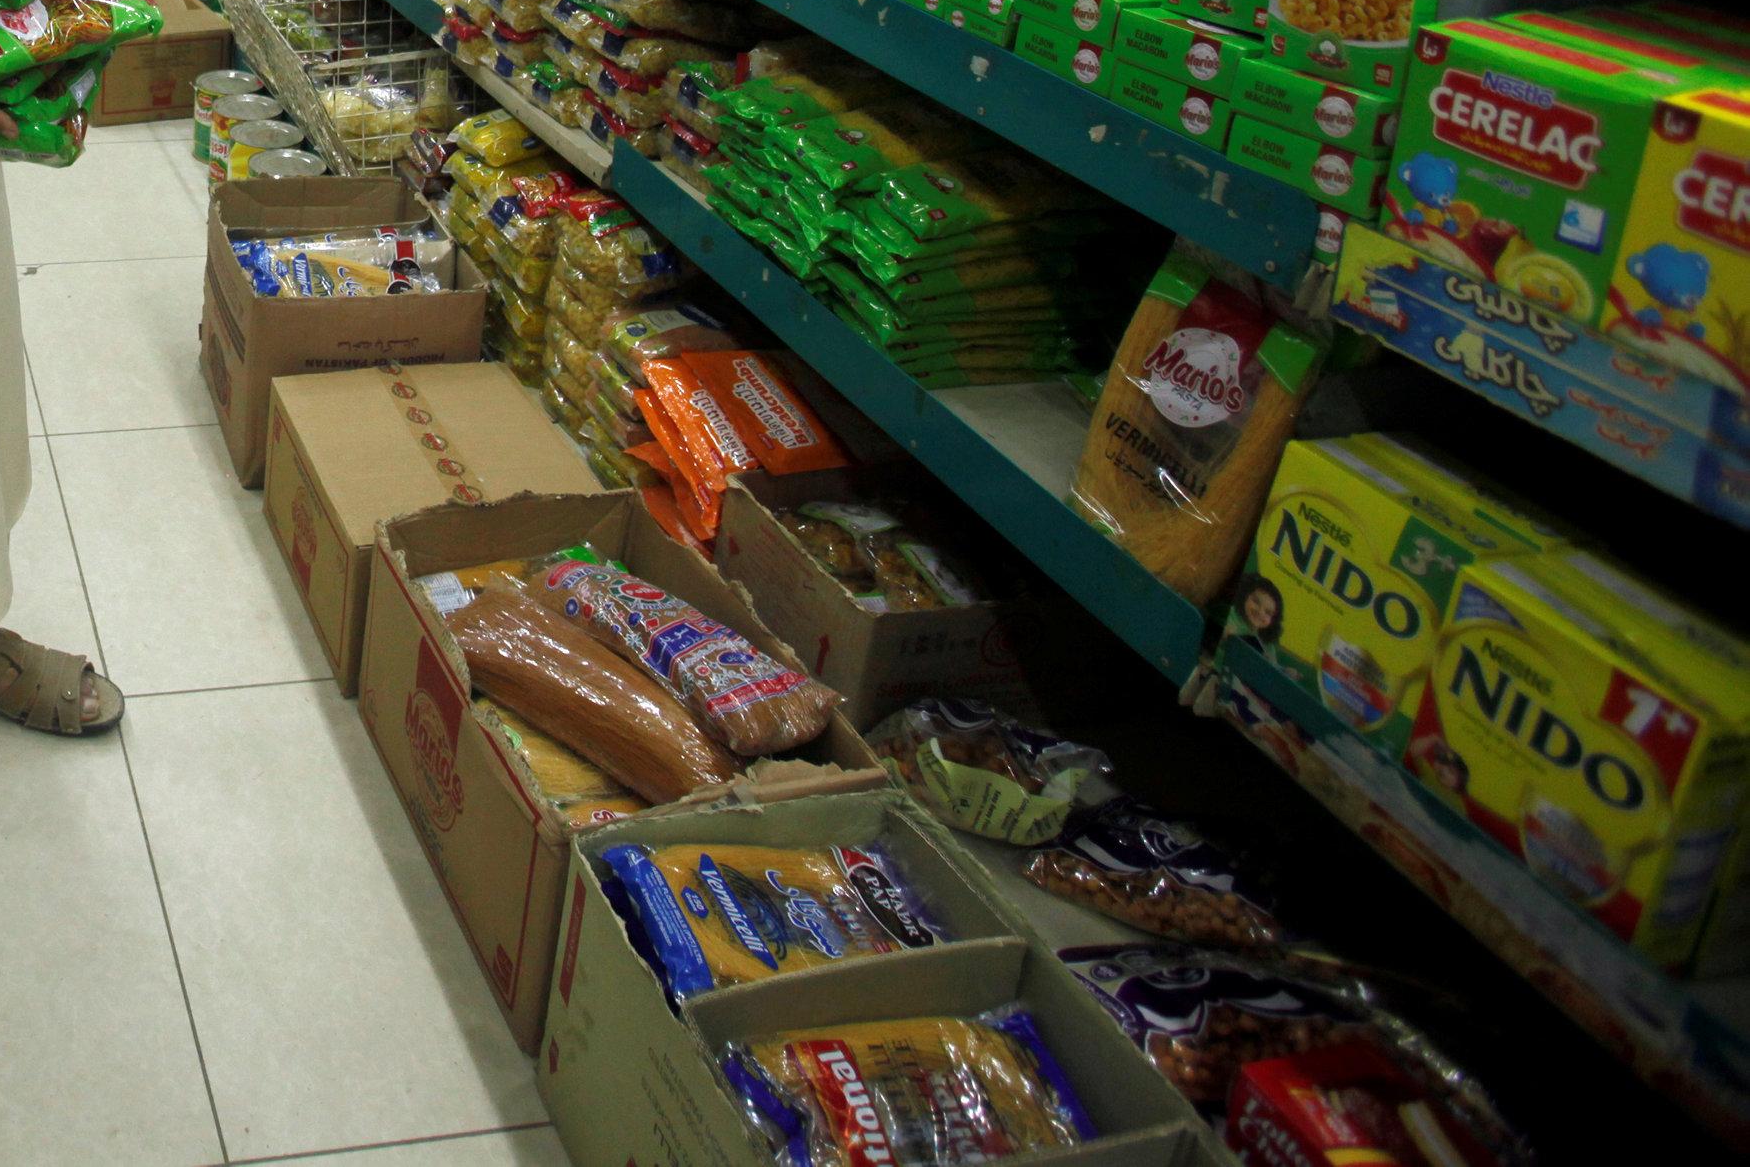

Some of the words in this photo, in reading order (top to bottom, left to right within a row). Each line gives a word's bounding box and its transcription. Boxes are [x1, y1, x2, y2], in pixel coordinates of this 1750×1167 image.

[1428, 85, 1602, 173] CERELAC
[734, 360, 809, 445] Breadcrumbs
[1143, 340, 1245, 413] Mario's
[1171, 387, 1204, 412] PASTA
[1105, 412, 1208, 498] VERMICELLI
[1269, 508, 1422, 639] NIDO
[1449, 644, 1644, 812] NIDO
[700, 866, 768, 954] Vermicelli
[816, 1048, 895, 1167] tional
